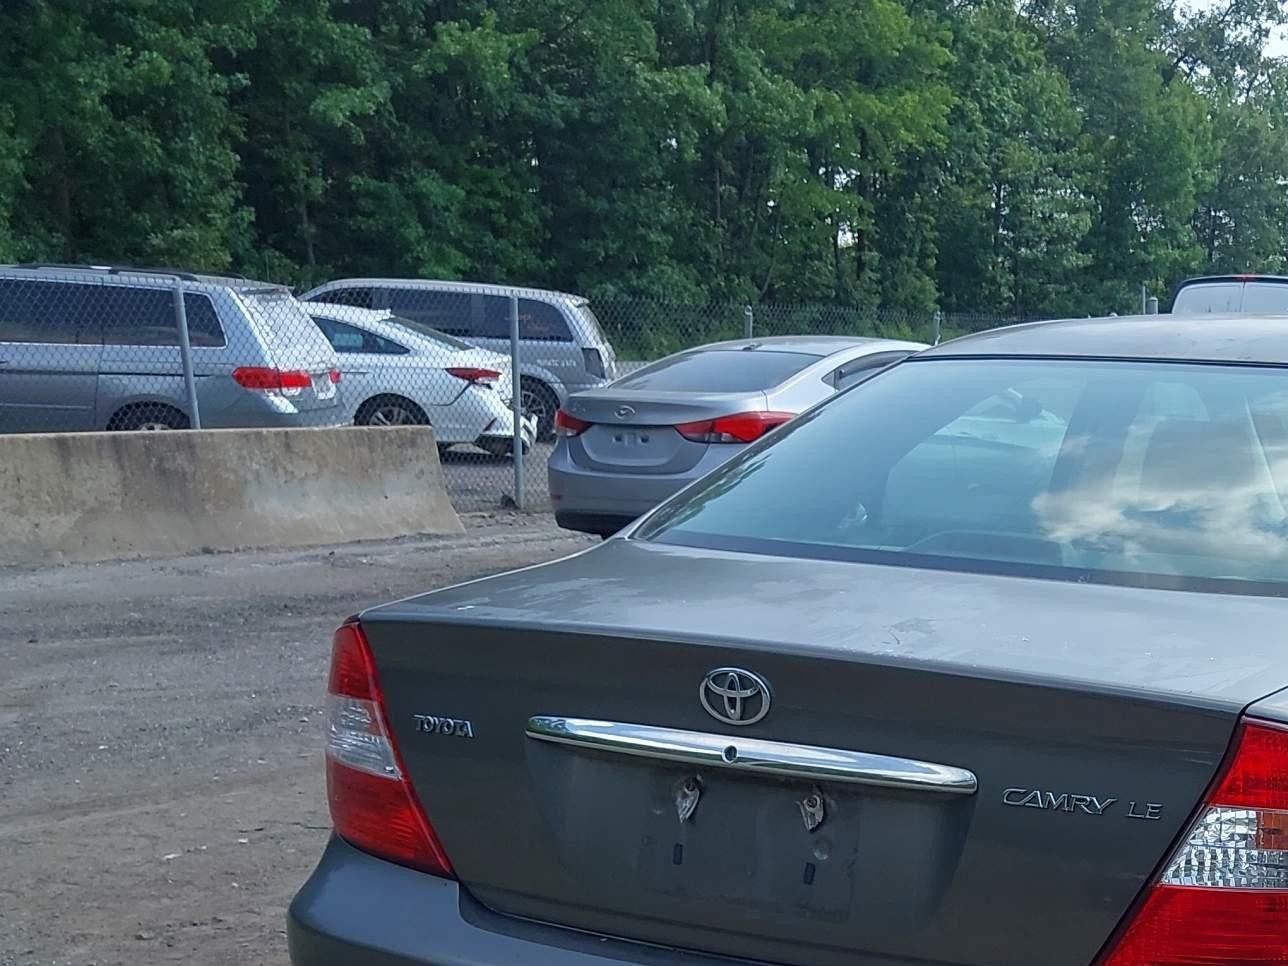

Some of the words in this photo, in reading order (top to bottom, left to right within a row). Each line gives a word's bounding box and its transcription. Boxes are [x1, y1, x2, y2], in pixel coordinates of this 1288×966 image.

[413, 714, 473, 737] TOYOTA
[1002, 788, 1117, 815] CAMRY
[1127, 801, 1163, 820] LE
